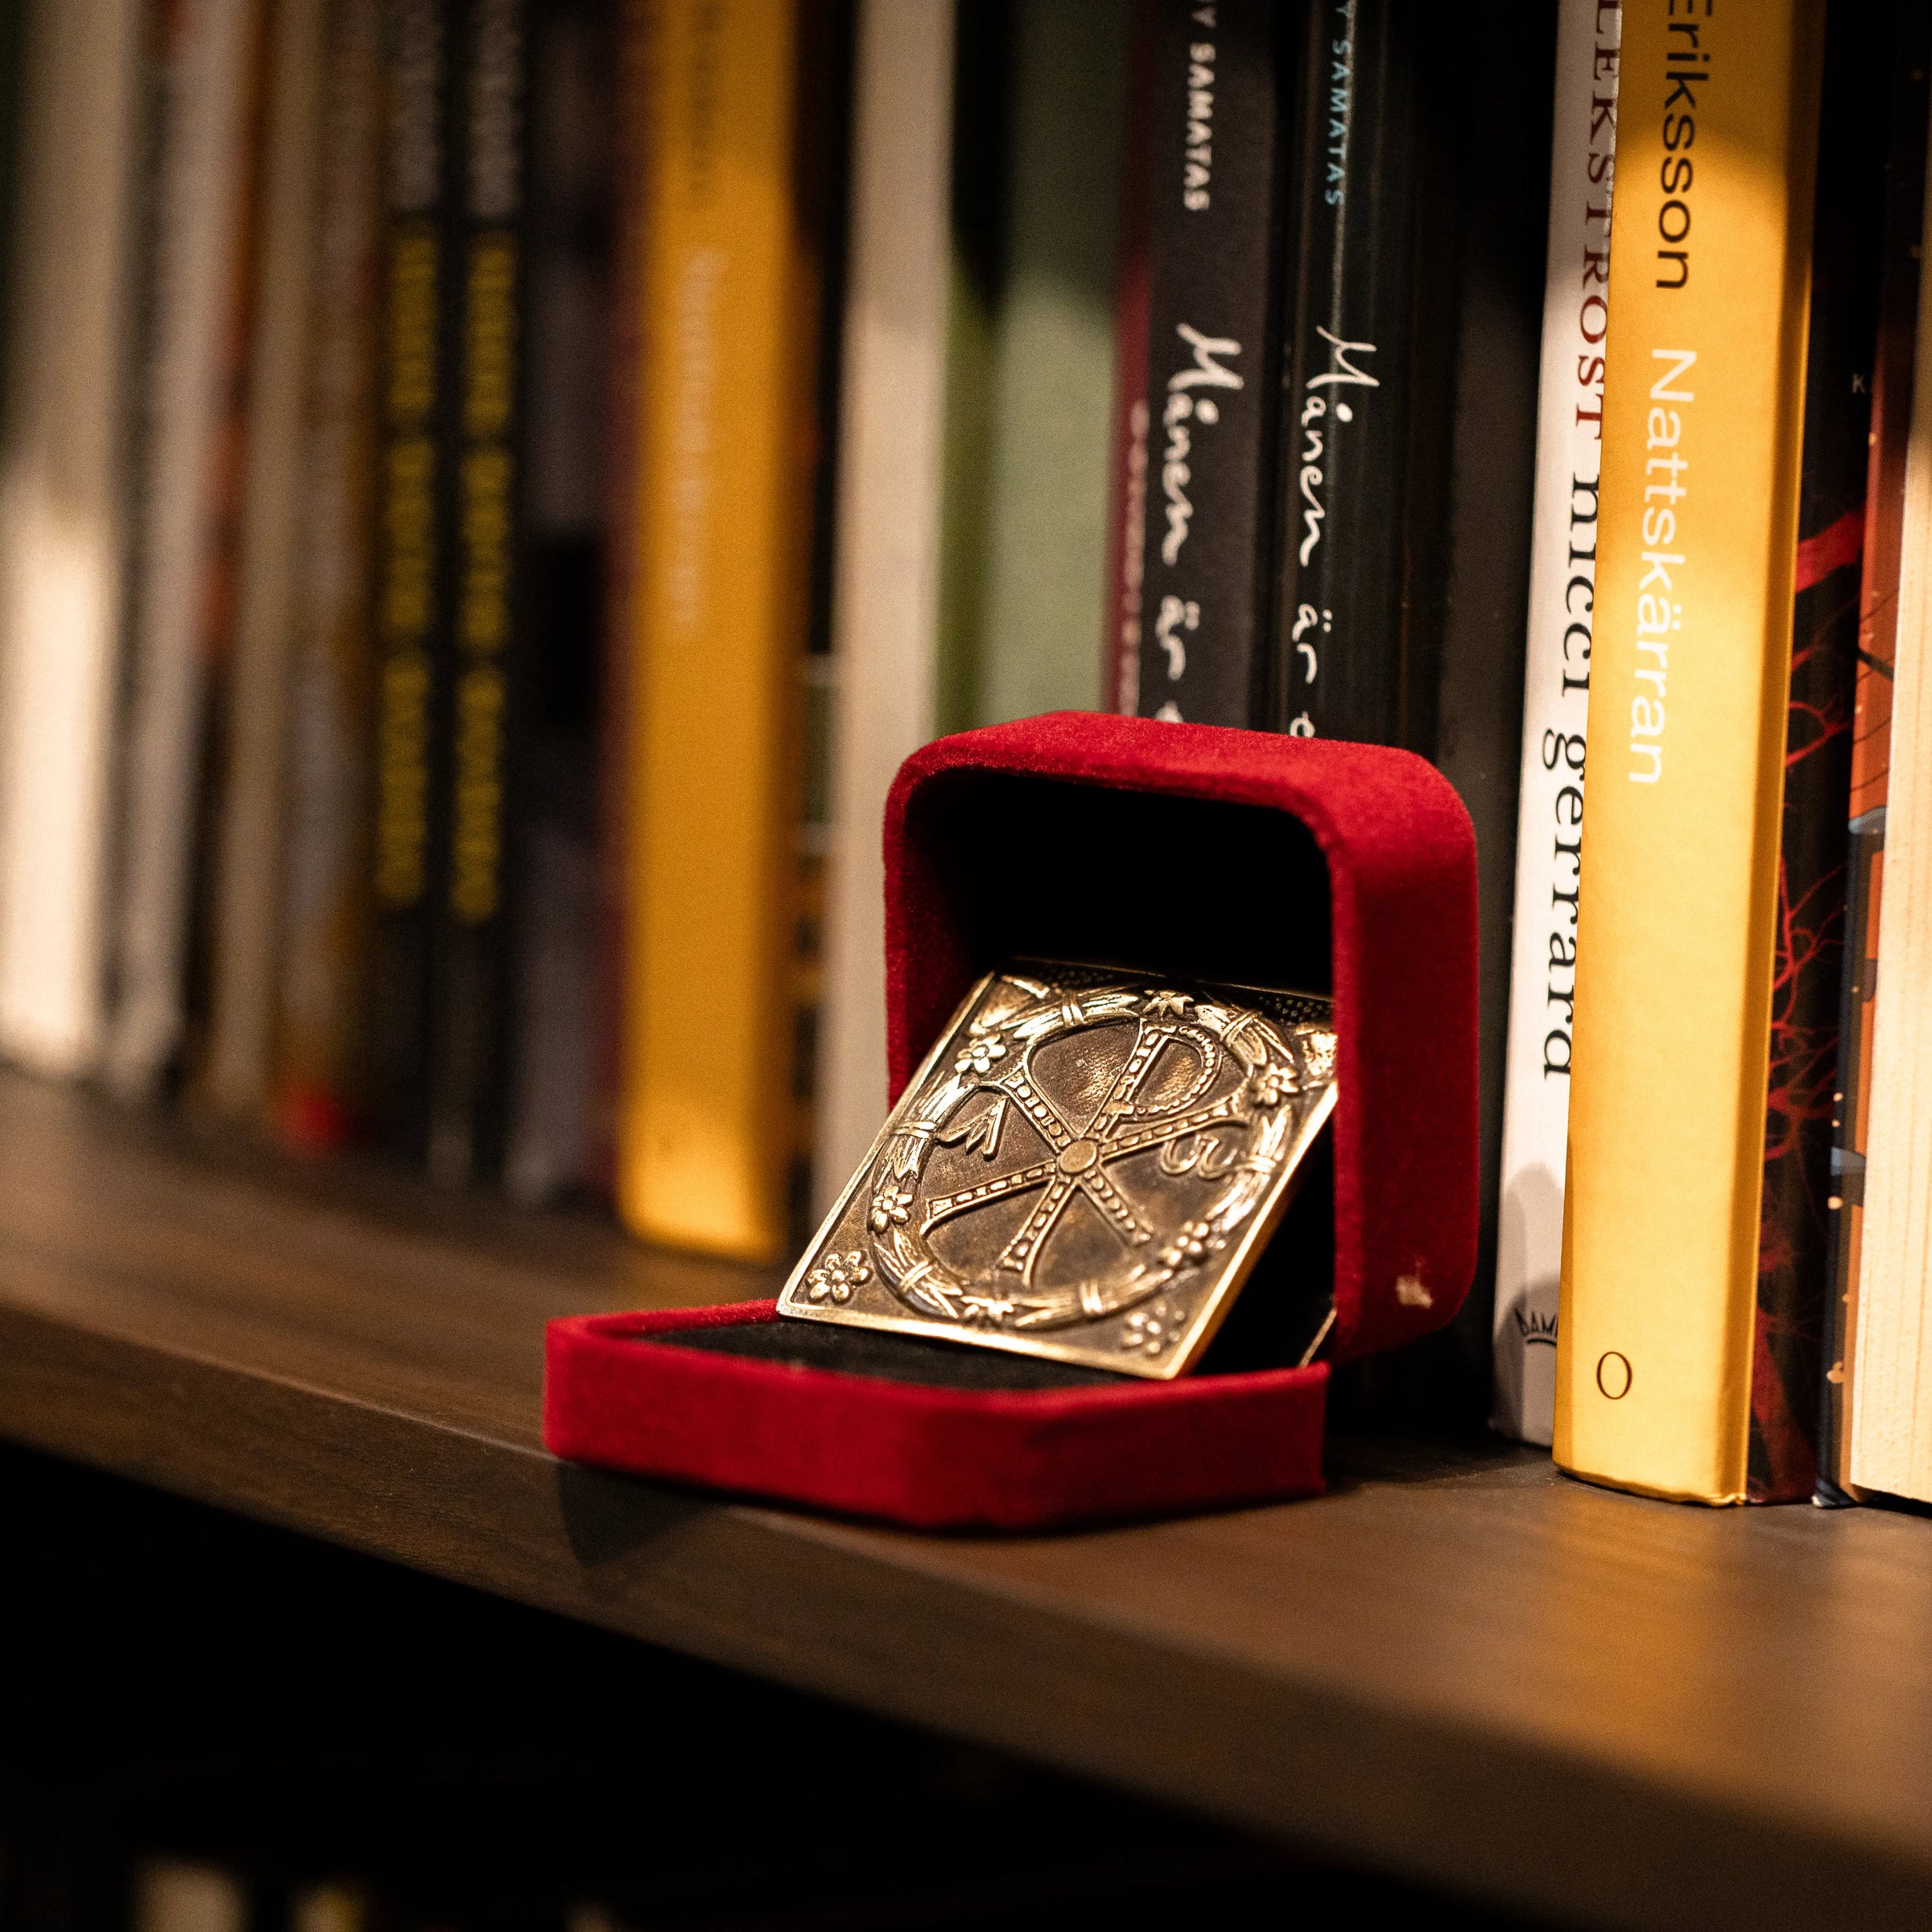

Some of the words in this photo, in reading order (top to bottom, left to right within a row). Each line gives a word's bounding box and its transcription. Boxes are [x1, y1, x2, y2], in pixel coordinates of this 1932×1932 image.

[1183, 42, 1216, 211] SAMATAS
[1324, 39, 1353, 206] SAMATAS
[1300, 325, 1380, 567] Månen
[1292, 603, 1332, 684] är
[1629, 349, 1697, 785] Nattskärran
[1513, 1307, 1558, 1337] DAM
